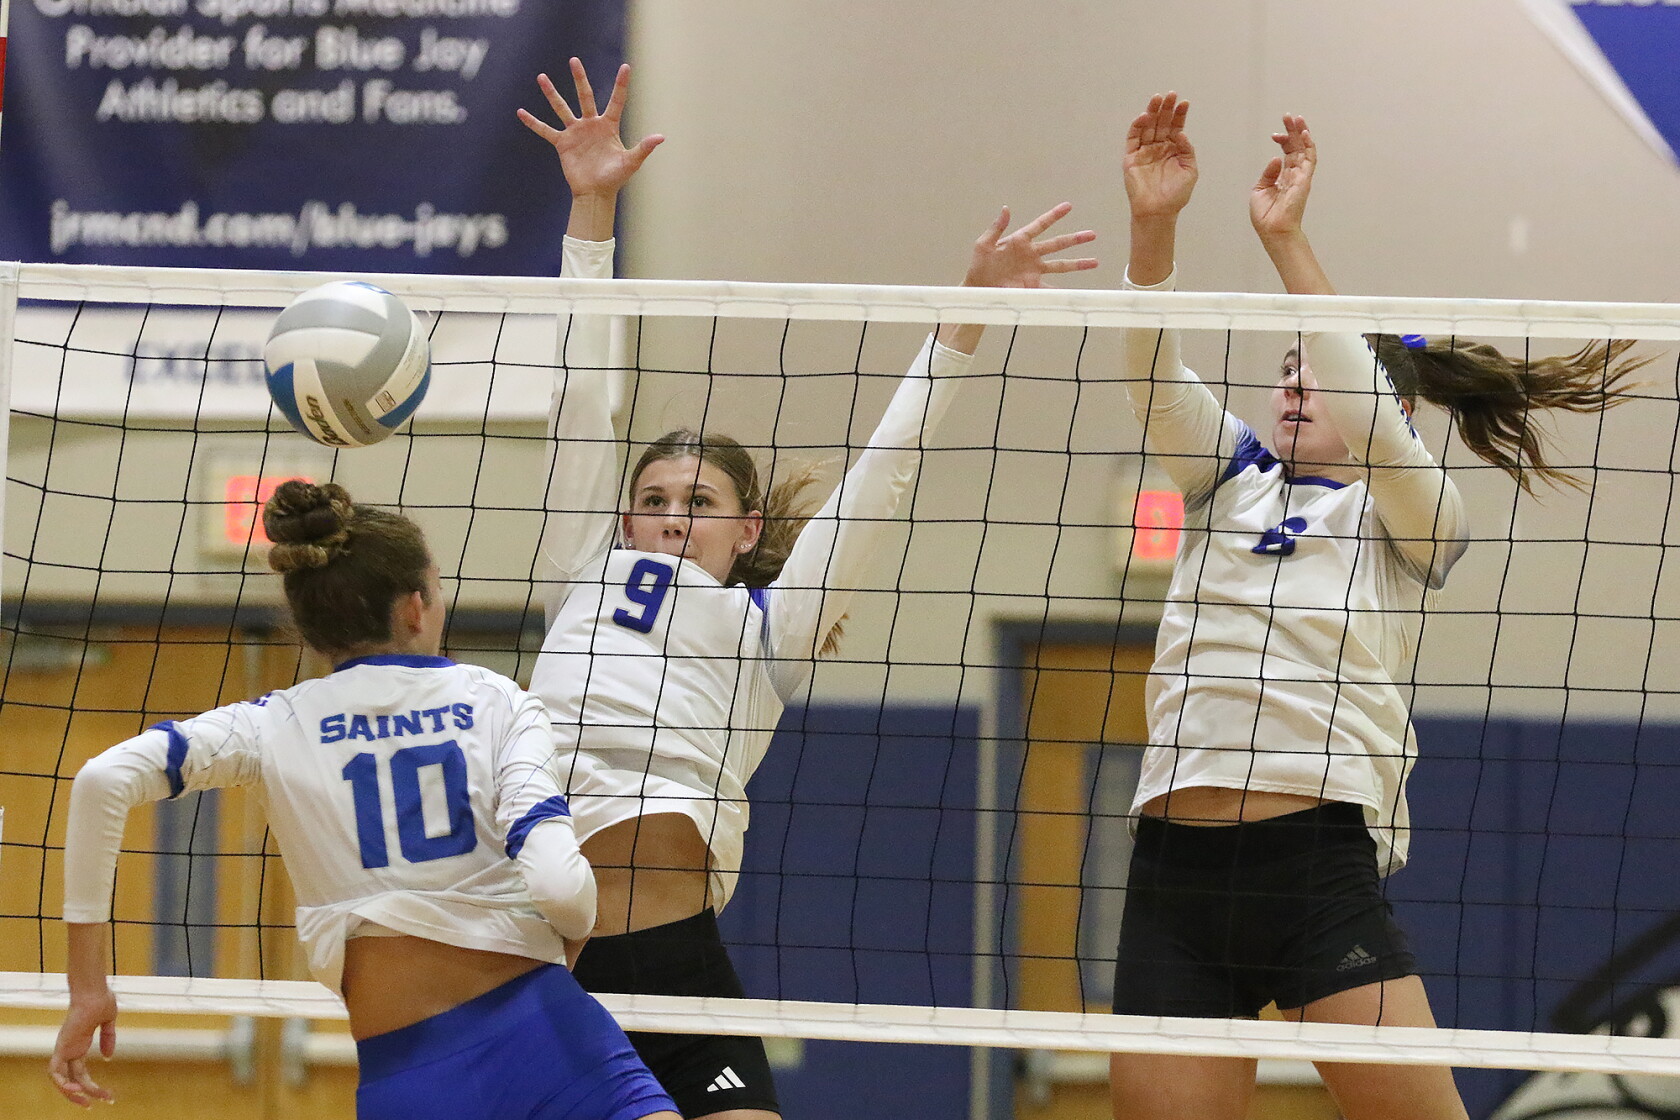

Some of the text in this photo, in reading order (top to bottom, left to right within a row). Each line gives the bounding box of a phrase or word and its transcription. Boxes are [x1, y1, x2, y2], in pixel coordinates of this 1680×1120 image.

[65, 24, 489, 80] Provider for Blue Jay
[96, 77, 265, 123] Athletics
[271, 79, 356, 124] and
[613, 559, 673, 634] 9
[320, 703, 474, 744] SAINTS
[342, 739, 478, 869] 10
